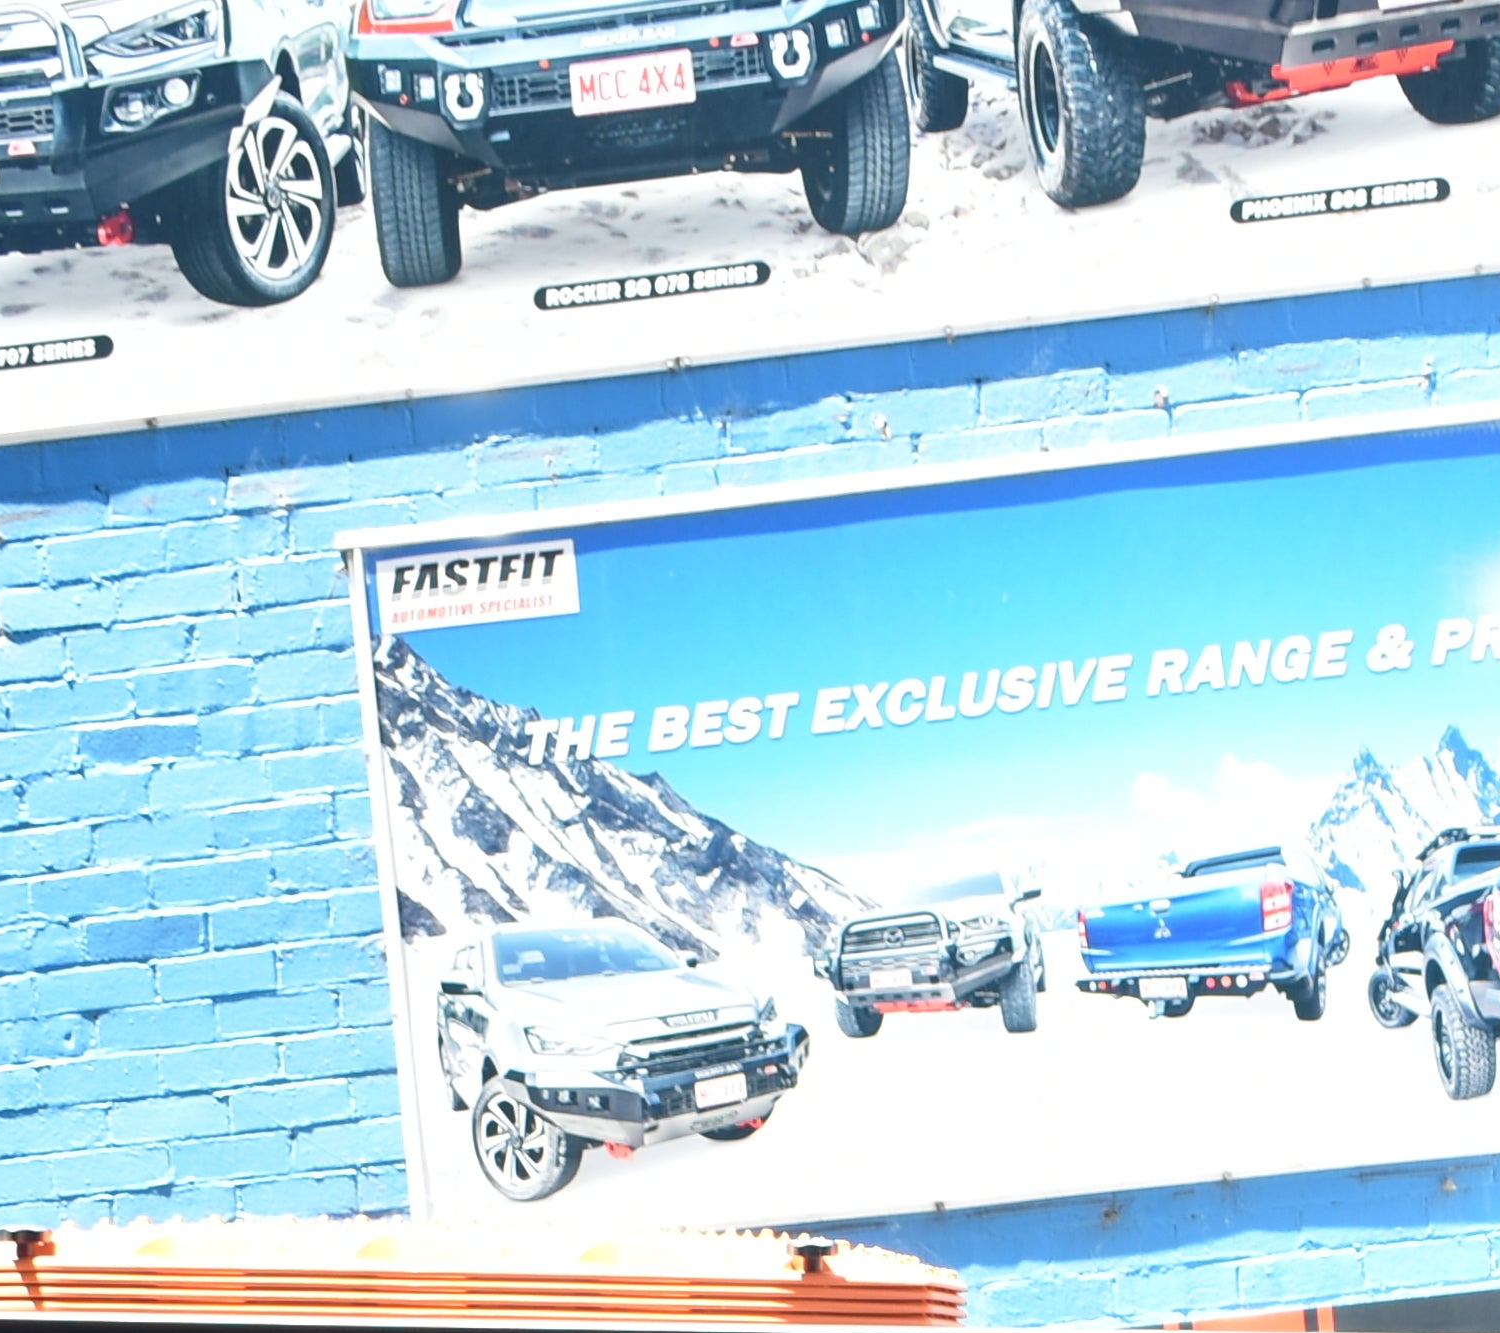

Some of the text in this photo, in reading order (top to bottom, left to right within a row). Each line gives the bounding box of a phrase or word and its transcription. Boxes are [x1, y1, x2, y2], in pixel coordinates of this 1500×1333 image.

[580, 62, 686, 103] MCC 4X4
[1241, 192, 1327, 220] PHOENIX
[1371, 180, 1438, 206] SERIES
[545, 280, 622, 307] ROCKER
[693, 264, 759, 290] SERIES
[32, 338, 97, 364] SERIES
[391, 548, 564, 602] FASTFIT
[392, 595, 554, 624] AUTOMOTIVE SPECIALIST
[524, 710, 635, 766] THE
[647, 691, 800, 753] BEST
[810, 654, 1134, 735] EXCLUSIVE
[1145, 629, 1355, 697] RANGE
[1366, 624, 1415, 674] &
